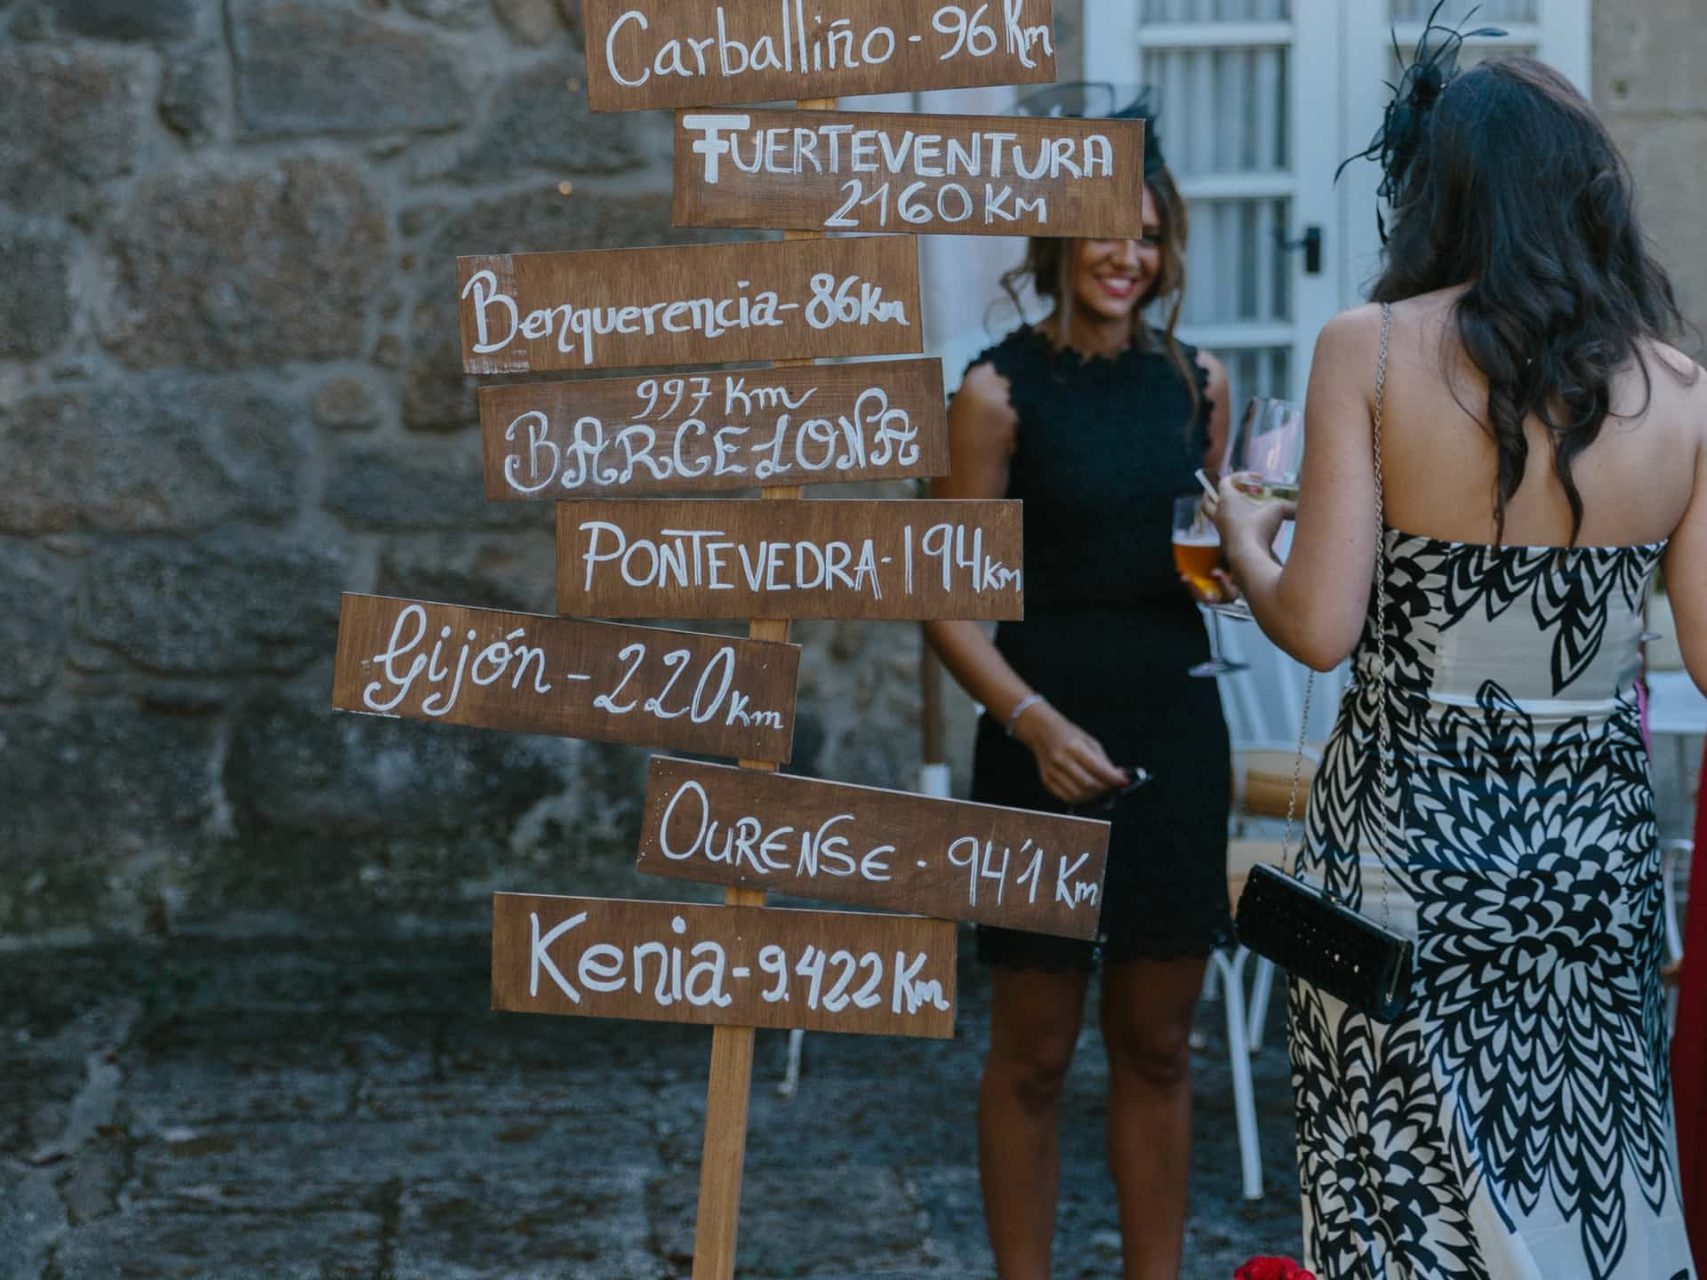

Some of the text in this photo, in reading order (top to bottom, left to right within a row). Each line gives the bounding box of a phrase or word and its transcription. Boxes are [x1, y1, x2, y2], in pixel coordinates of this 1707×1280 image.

[683, 114, 1113, 183] FUERTEVENTURA
[504, 387, 919, 493] BARCELONA
[631, 376, 711, 420] 997
[363, 604, 551, 717] Gijón
